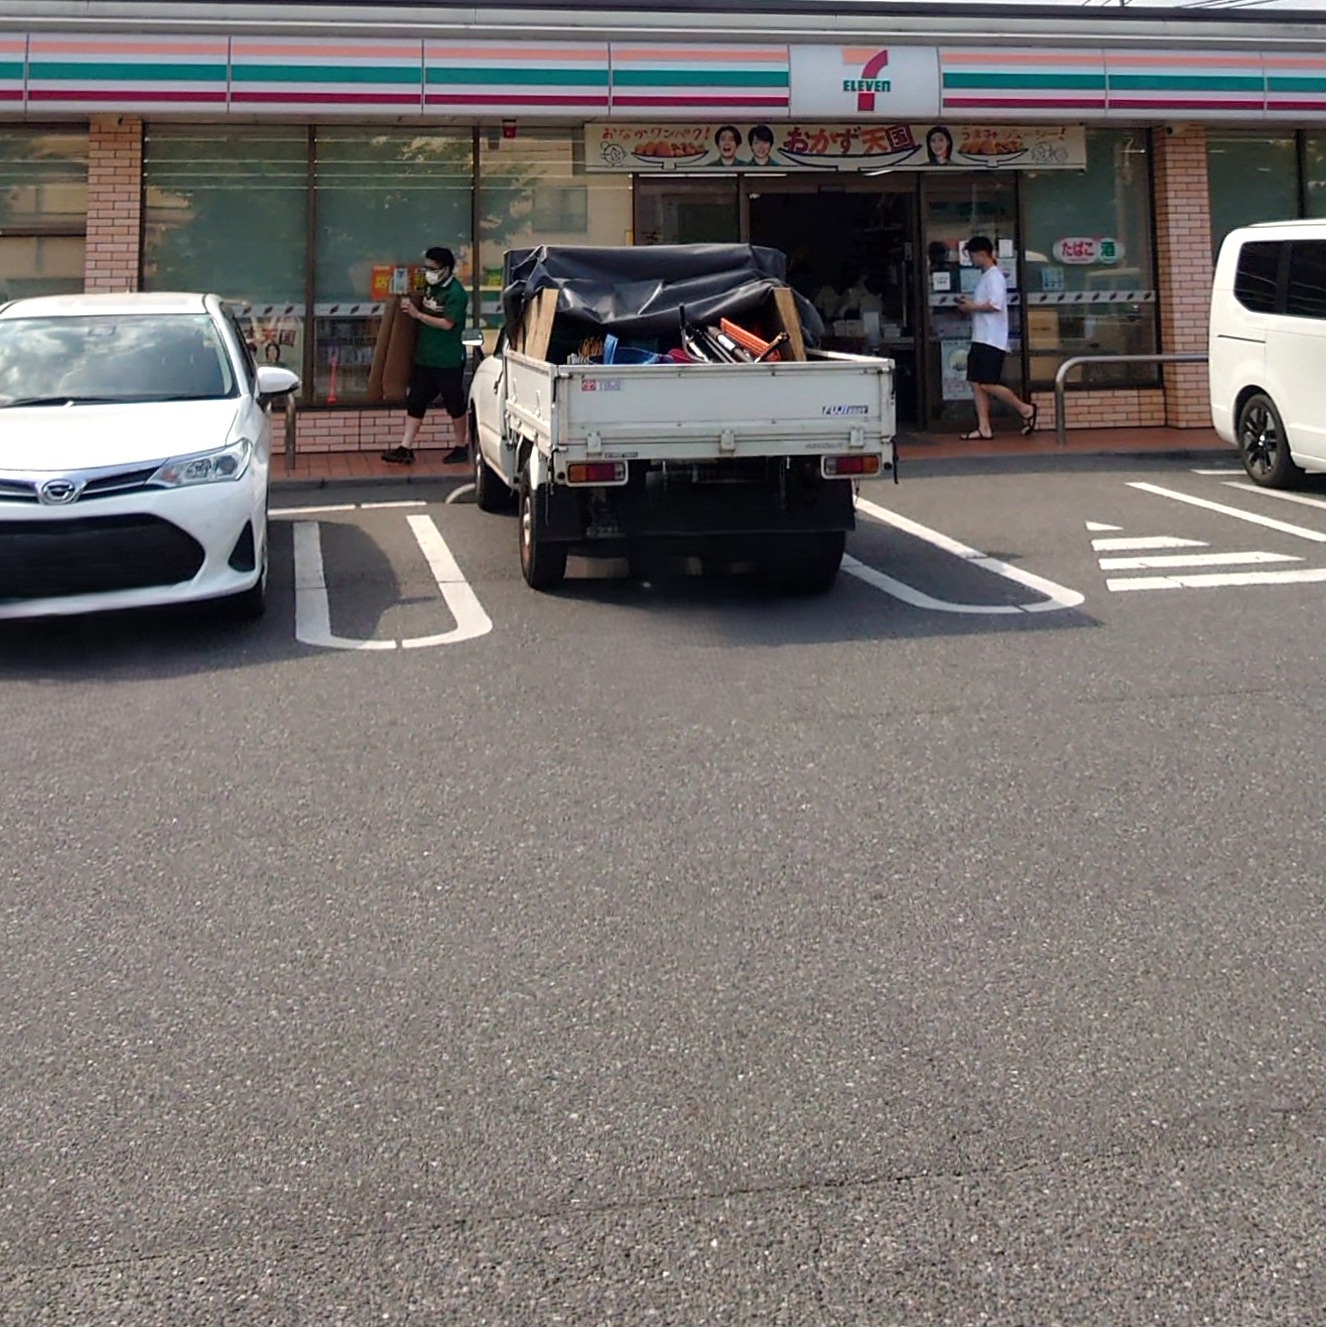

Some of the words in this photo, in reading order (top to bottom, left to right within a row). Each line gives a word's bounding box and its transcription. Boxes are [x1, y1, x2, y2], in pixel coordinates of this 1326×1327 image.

[783, 123, 916, 154] おかず天国
[1061, 241, 1094, 257] たばこ
[1100, 241, 1116, 257] 酒
